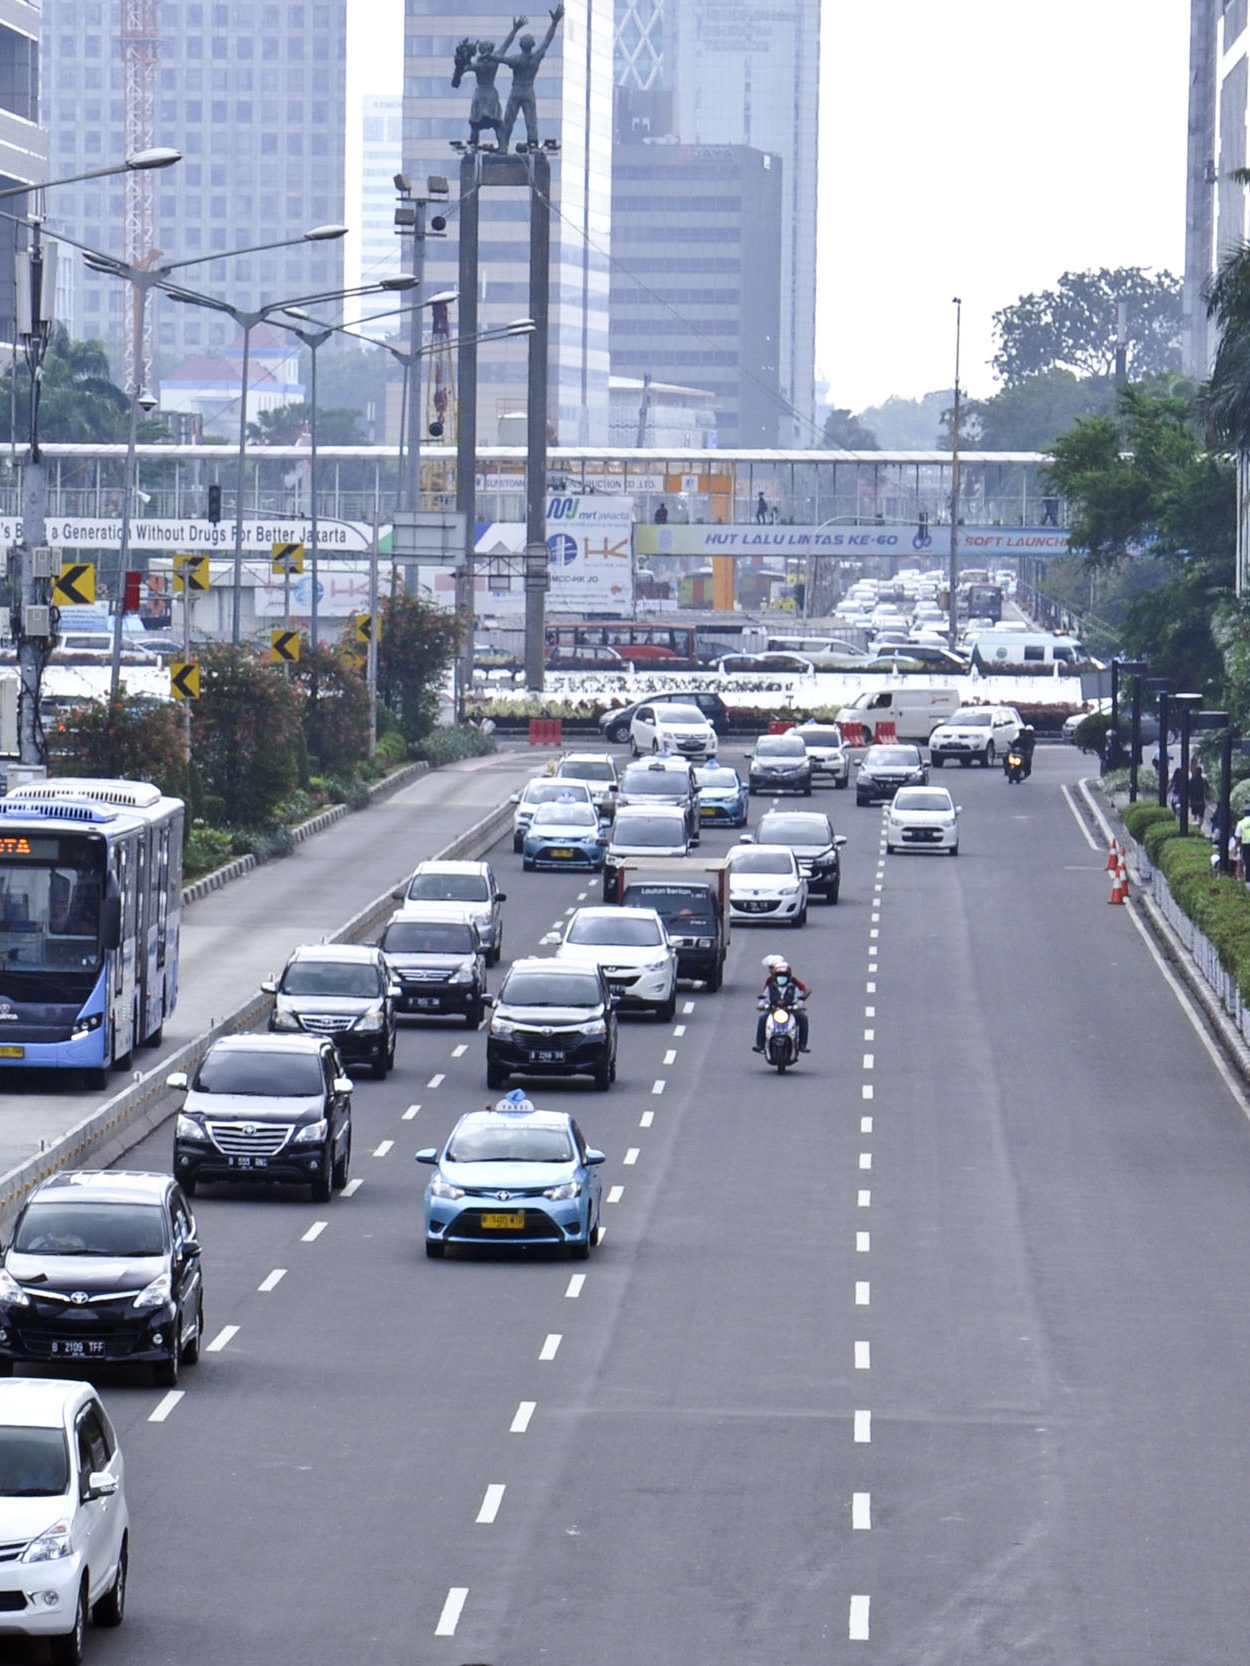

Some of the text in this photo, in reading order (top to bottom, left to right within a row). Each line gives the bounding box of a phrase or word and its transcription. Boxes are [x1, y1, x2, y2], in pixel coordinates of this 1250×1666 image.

[51, 527, 59, 540] a
[137, 524, 184, 542] Without
[189, 525, 226, 546] Drugs
[257, 526, 295, 543] Better
[705, 533, 898, 546] HUT LALU LINTAS KE-60
[965, 536, 1003, 547] SOFT
[52, 1341, 103, 1353] B 2109 TFF
